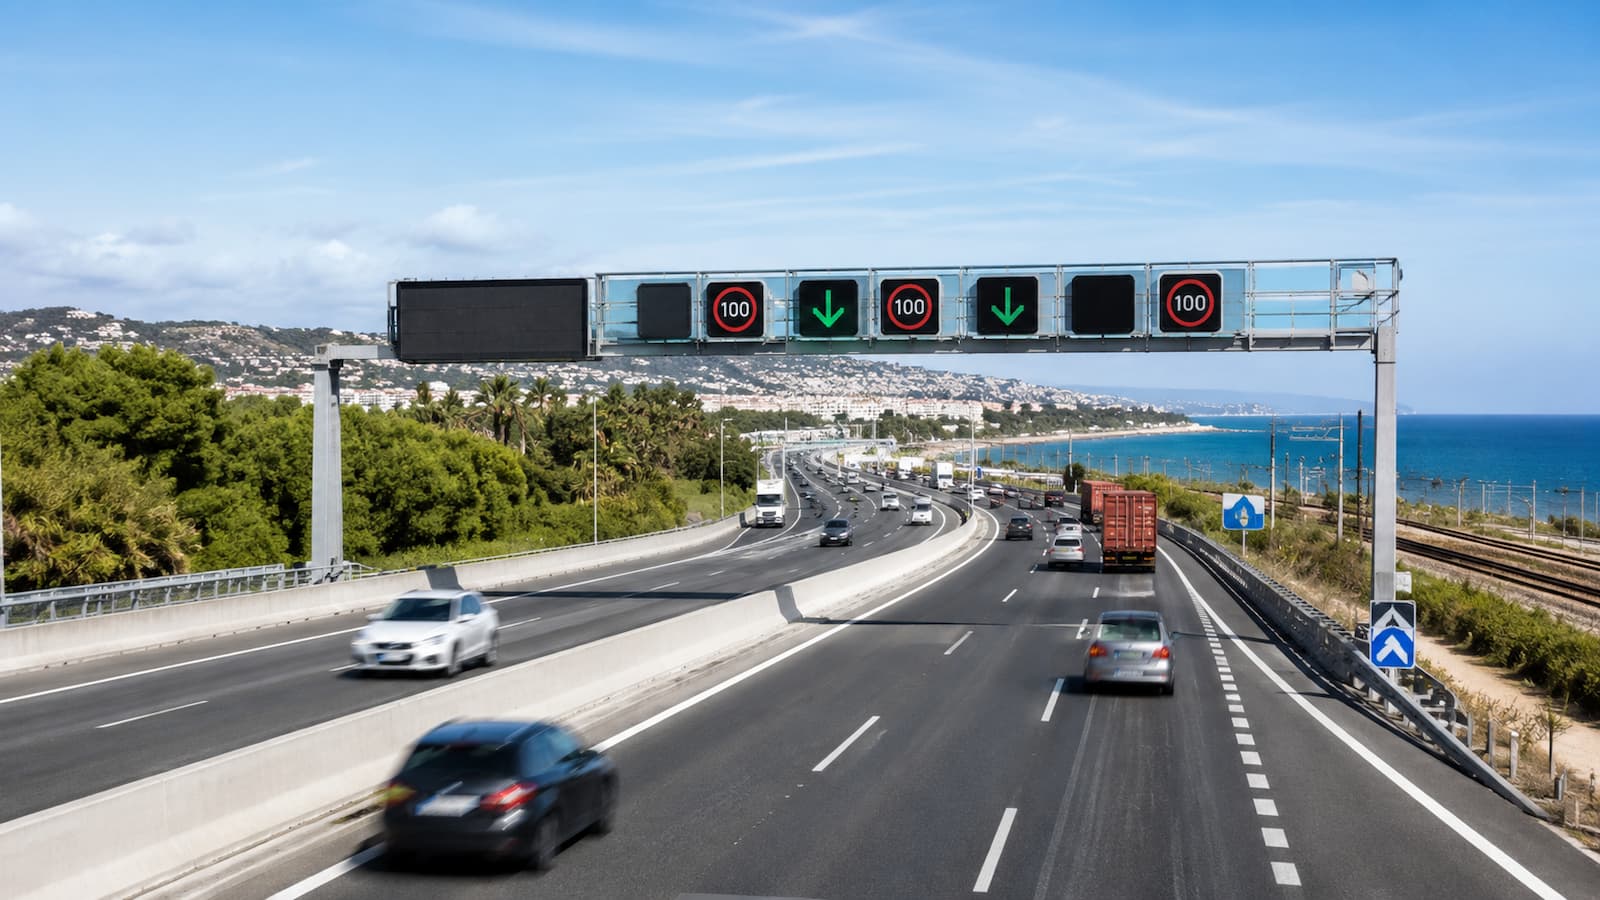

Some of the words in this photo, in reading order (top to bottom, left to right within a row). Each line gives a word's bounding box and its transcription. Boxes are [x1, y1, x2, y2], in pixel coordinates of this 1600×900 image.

[721, 301, 750, 317] 100
[895, 299, 924, 315] 100
[1174, 295, 1206, 311] 100
